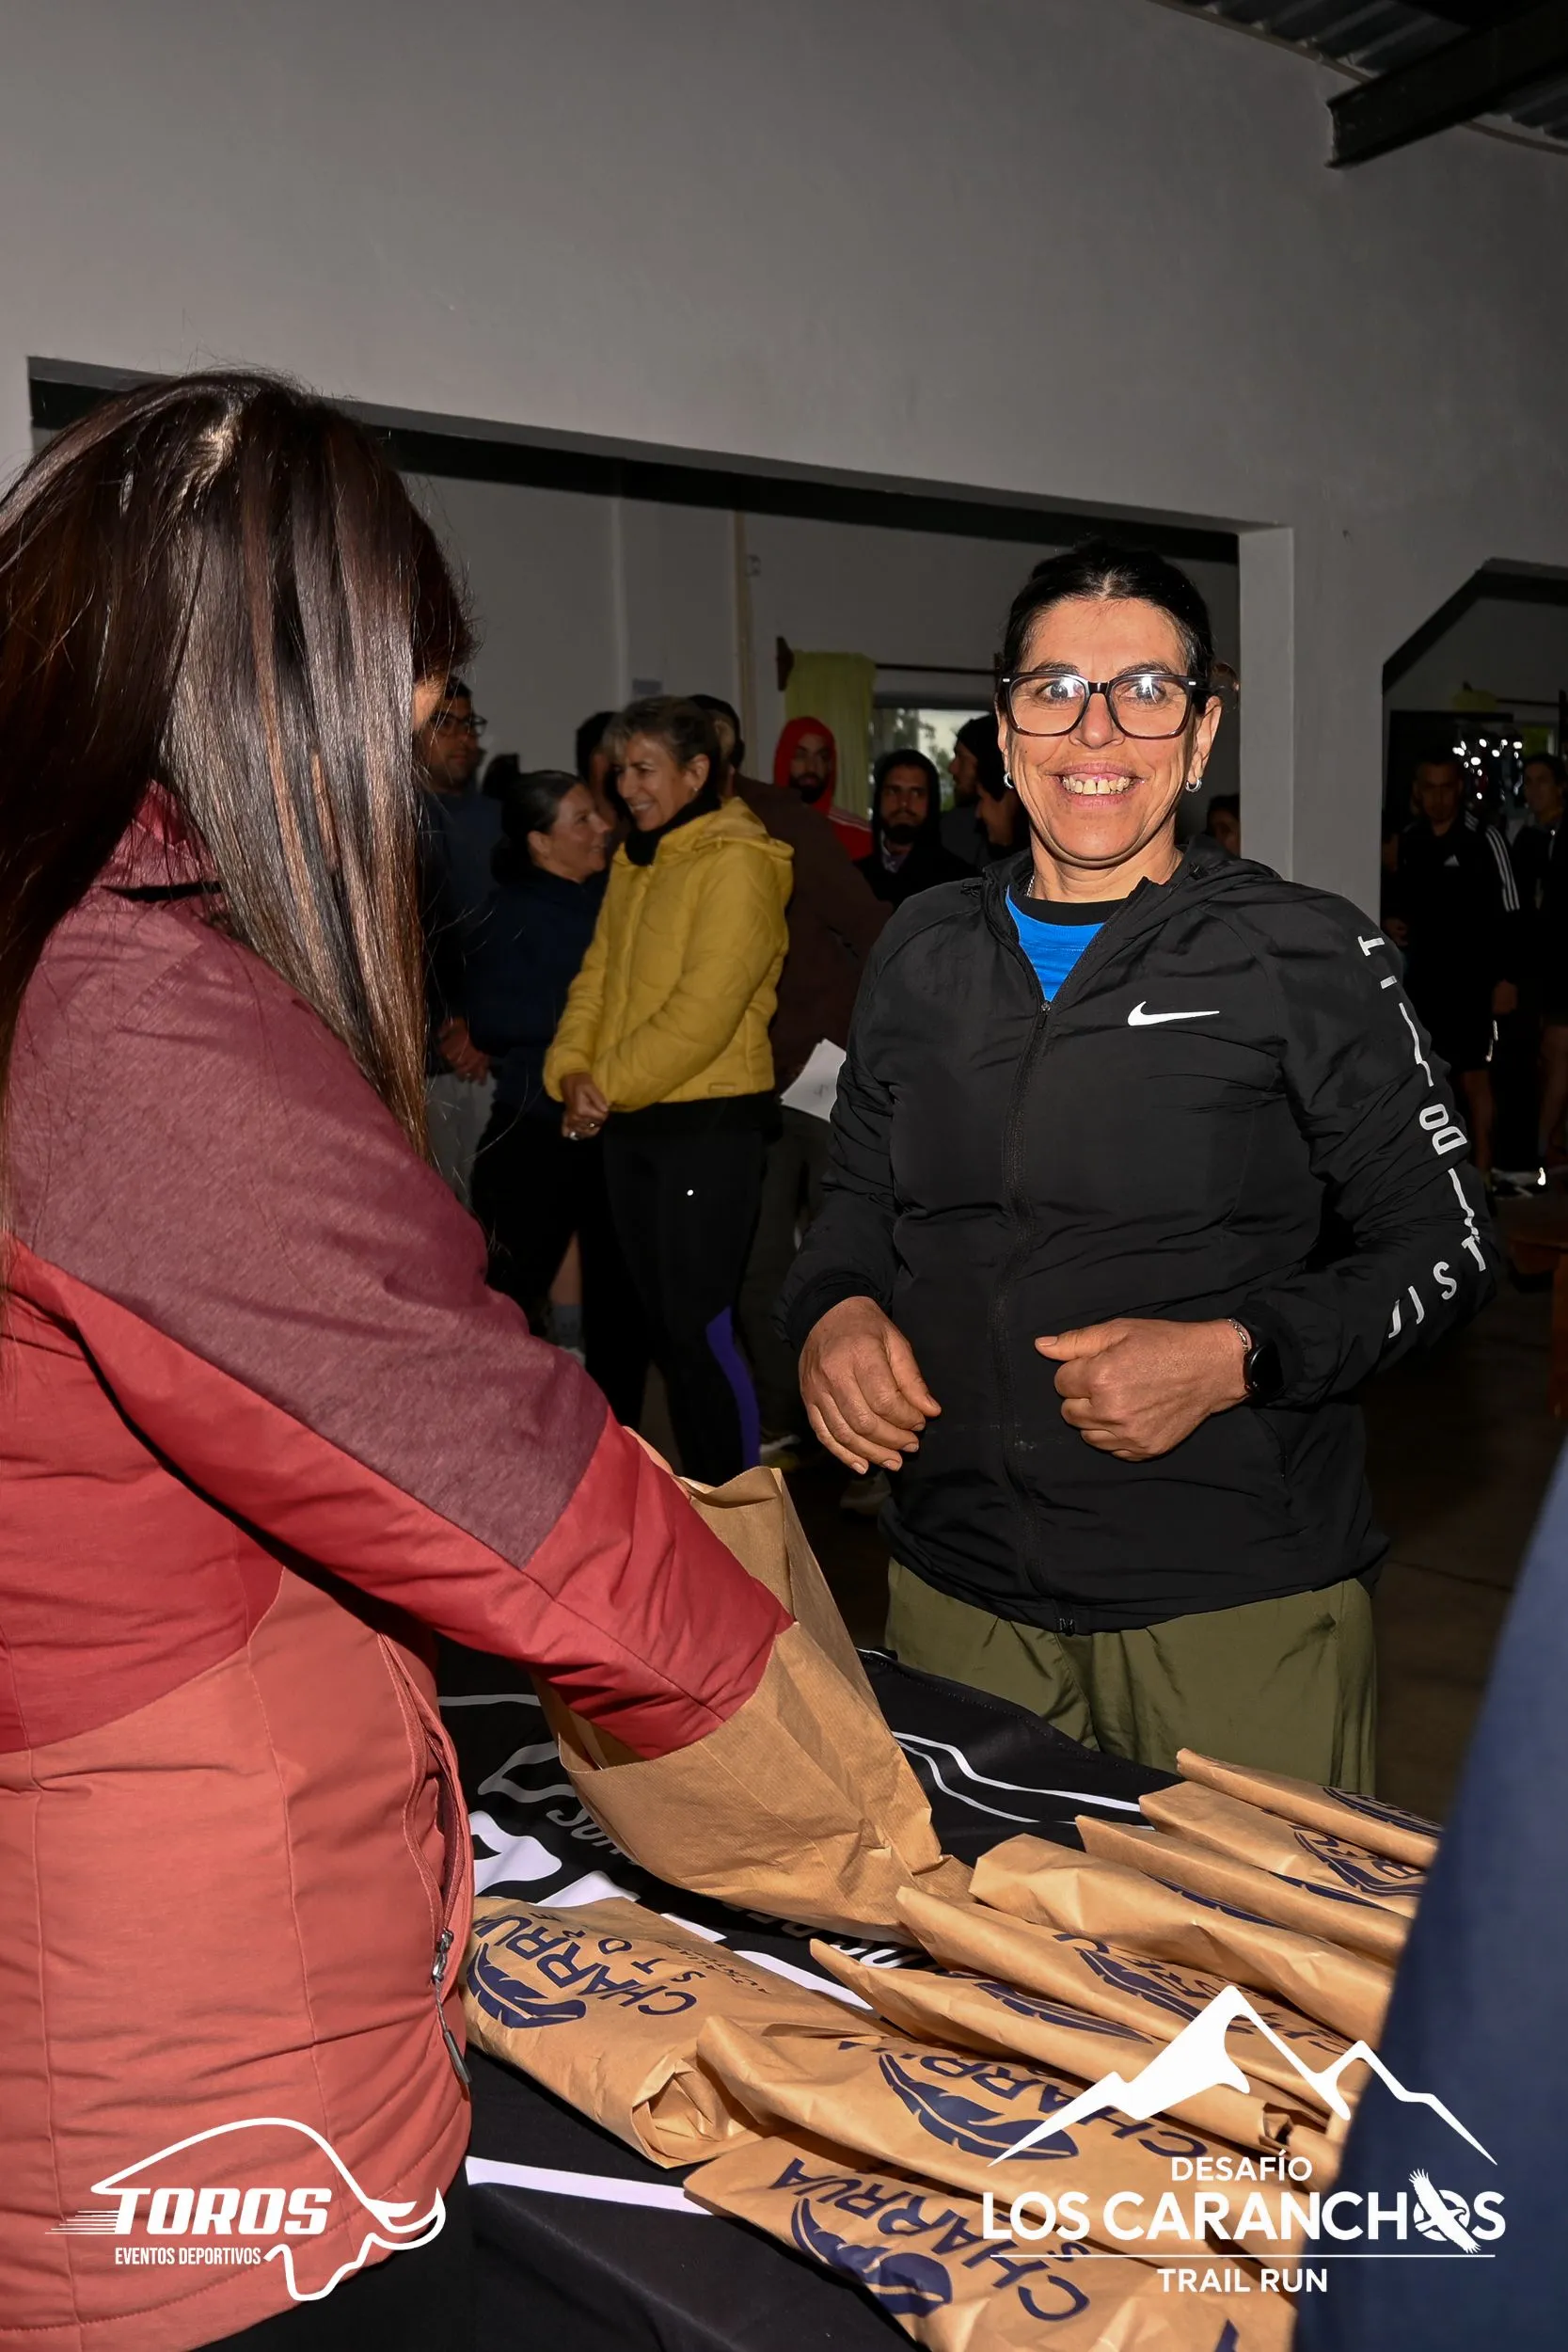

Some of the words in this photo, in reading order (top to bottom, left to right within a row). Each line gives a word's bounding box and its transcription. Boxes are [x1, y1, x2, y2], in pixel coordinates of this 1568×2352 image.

[1357, 935, 1398, 989] IT
[1418, 1104, 1467, 1155] DO
[837, 2040, 1208, 2158] CHARR
[767, 2157, 1091, 2322] CHARRUA
